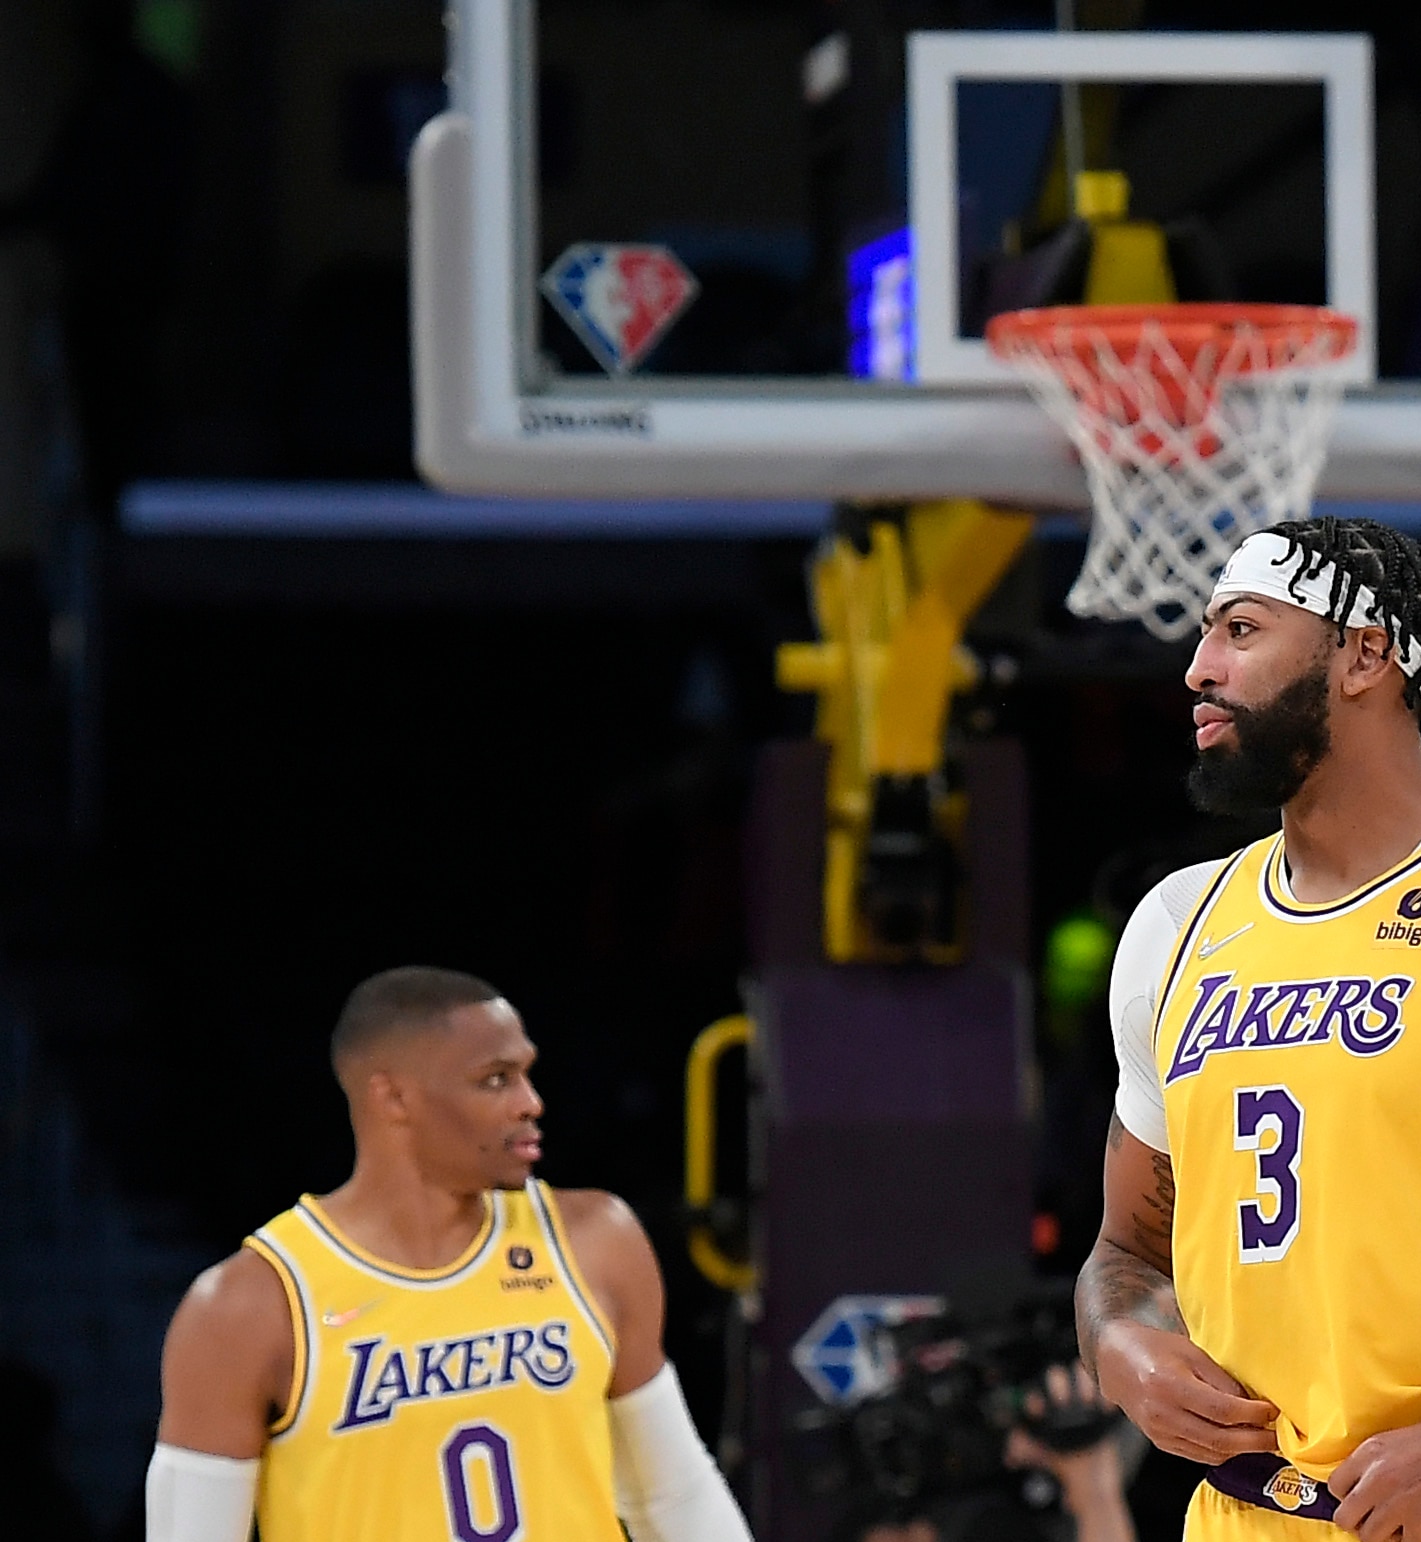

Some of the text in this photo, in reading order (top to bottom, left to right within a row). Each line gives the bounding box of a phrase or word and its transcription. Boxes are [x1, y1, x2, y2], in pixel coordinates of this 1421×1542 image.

[1163, 969, 1417, 1090] LAKERS
[1233, 1083, 1305, 1265] 3
[329, 1320, 576, 1436] LAKERS
